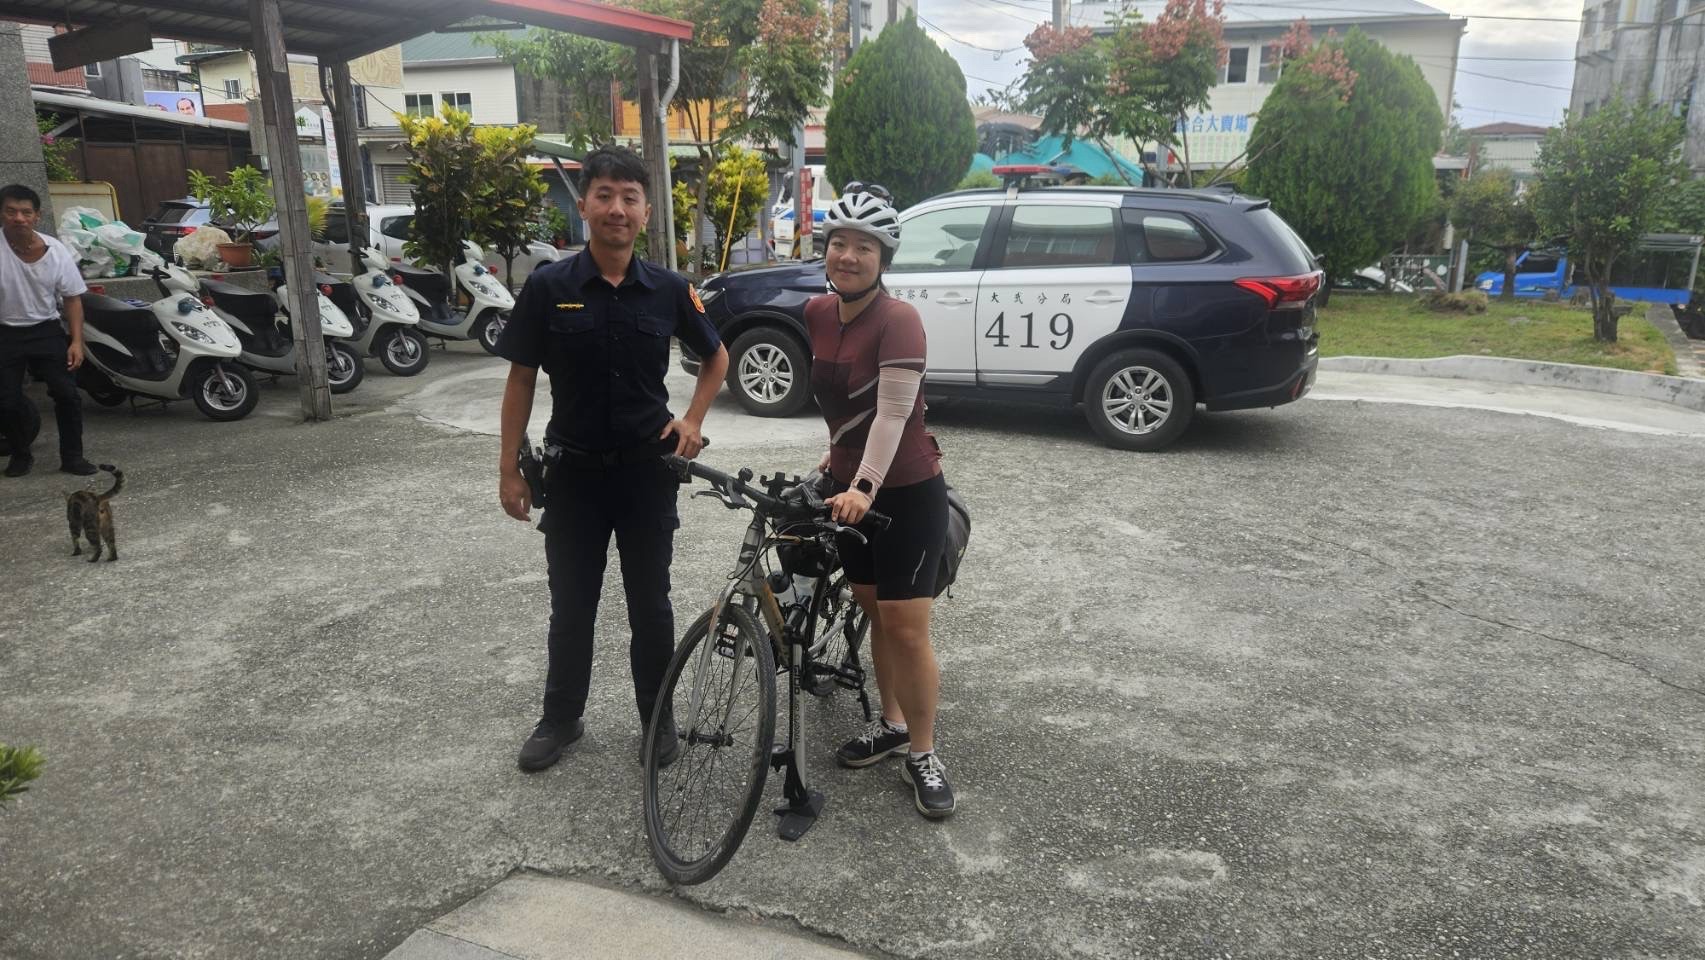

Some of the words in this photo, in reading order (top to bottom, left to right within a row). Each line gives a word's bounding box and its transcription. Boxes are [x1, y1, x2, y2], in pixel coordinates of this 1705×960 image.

[991, 291, 1071, 304] 大武分局
[985, 311, 1074, 350] 419
